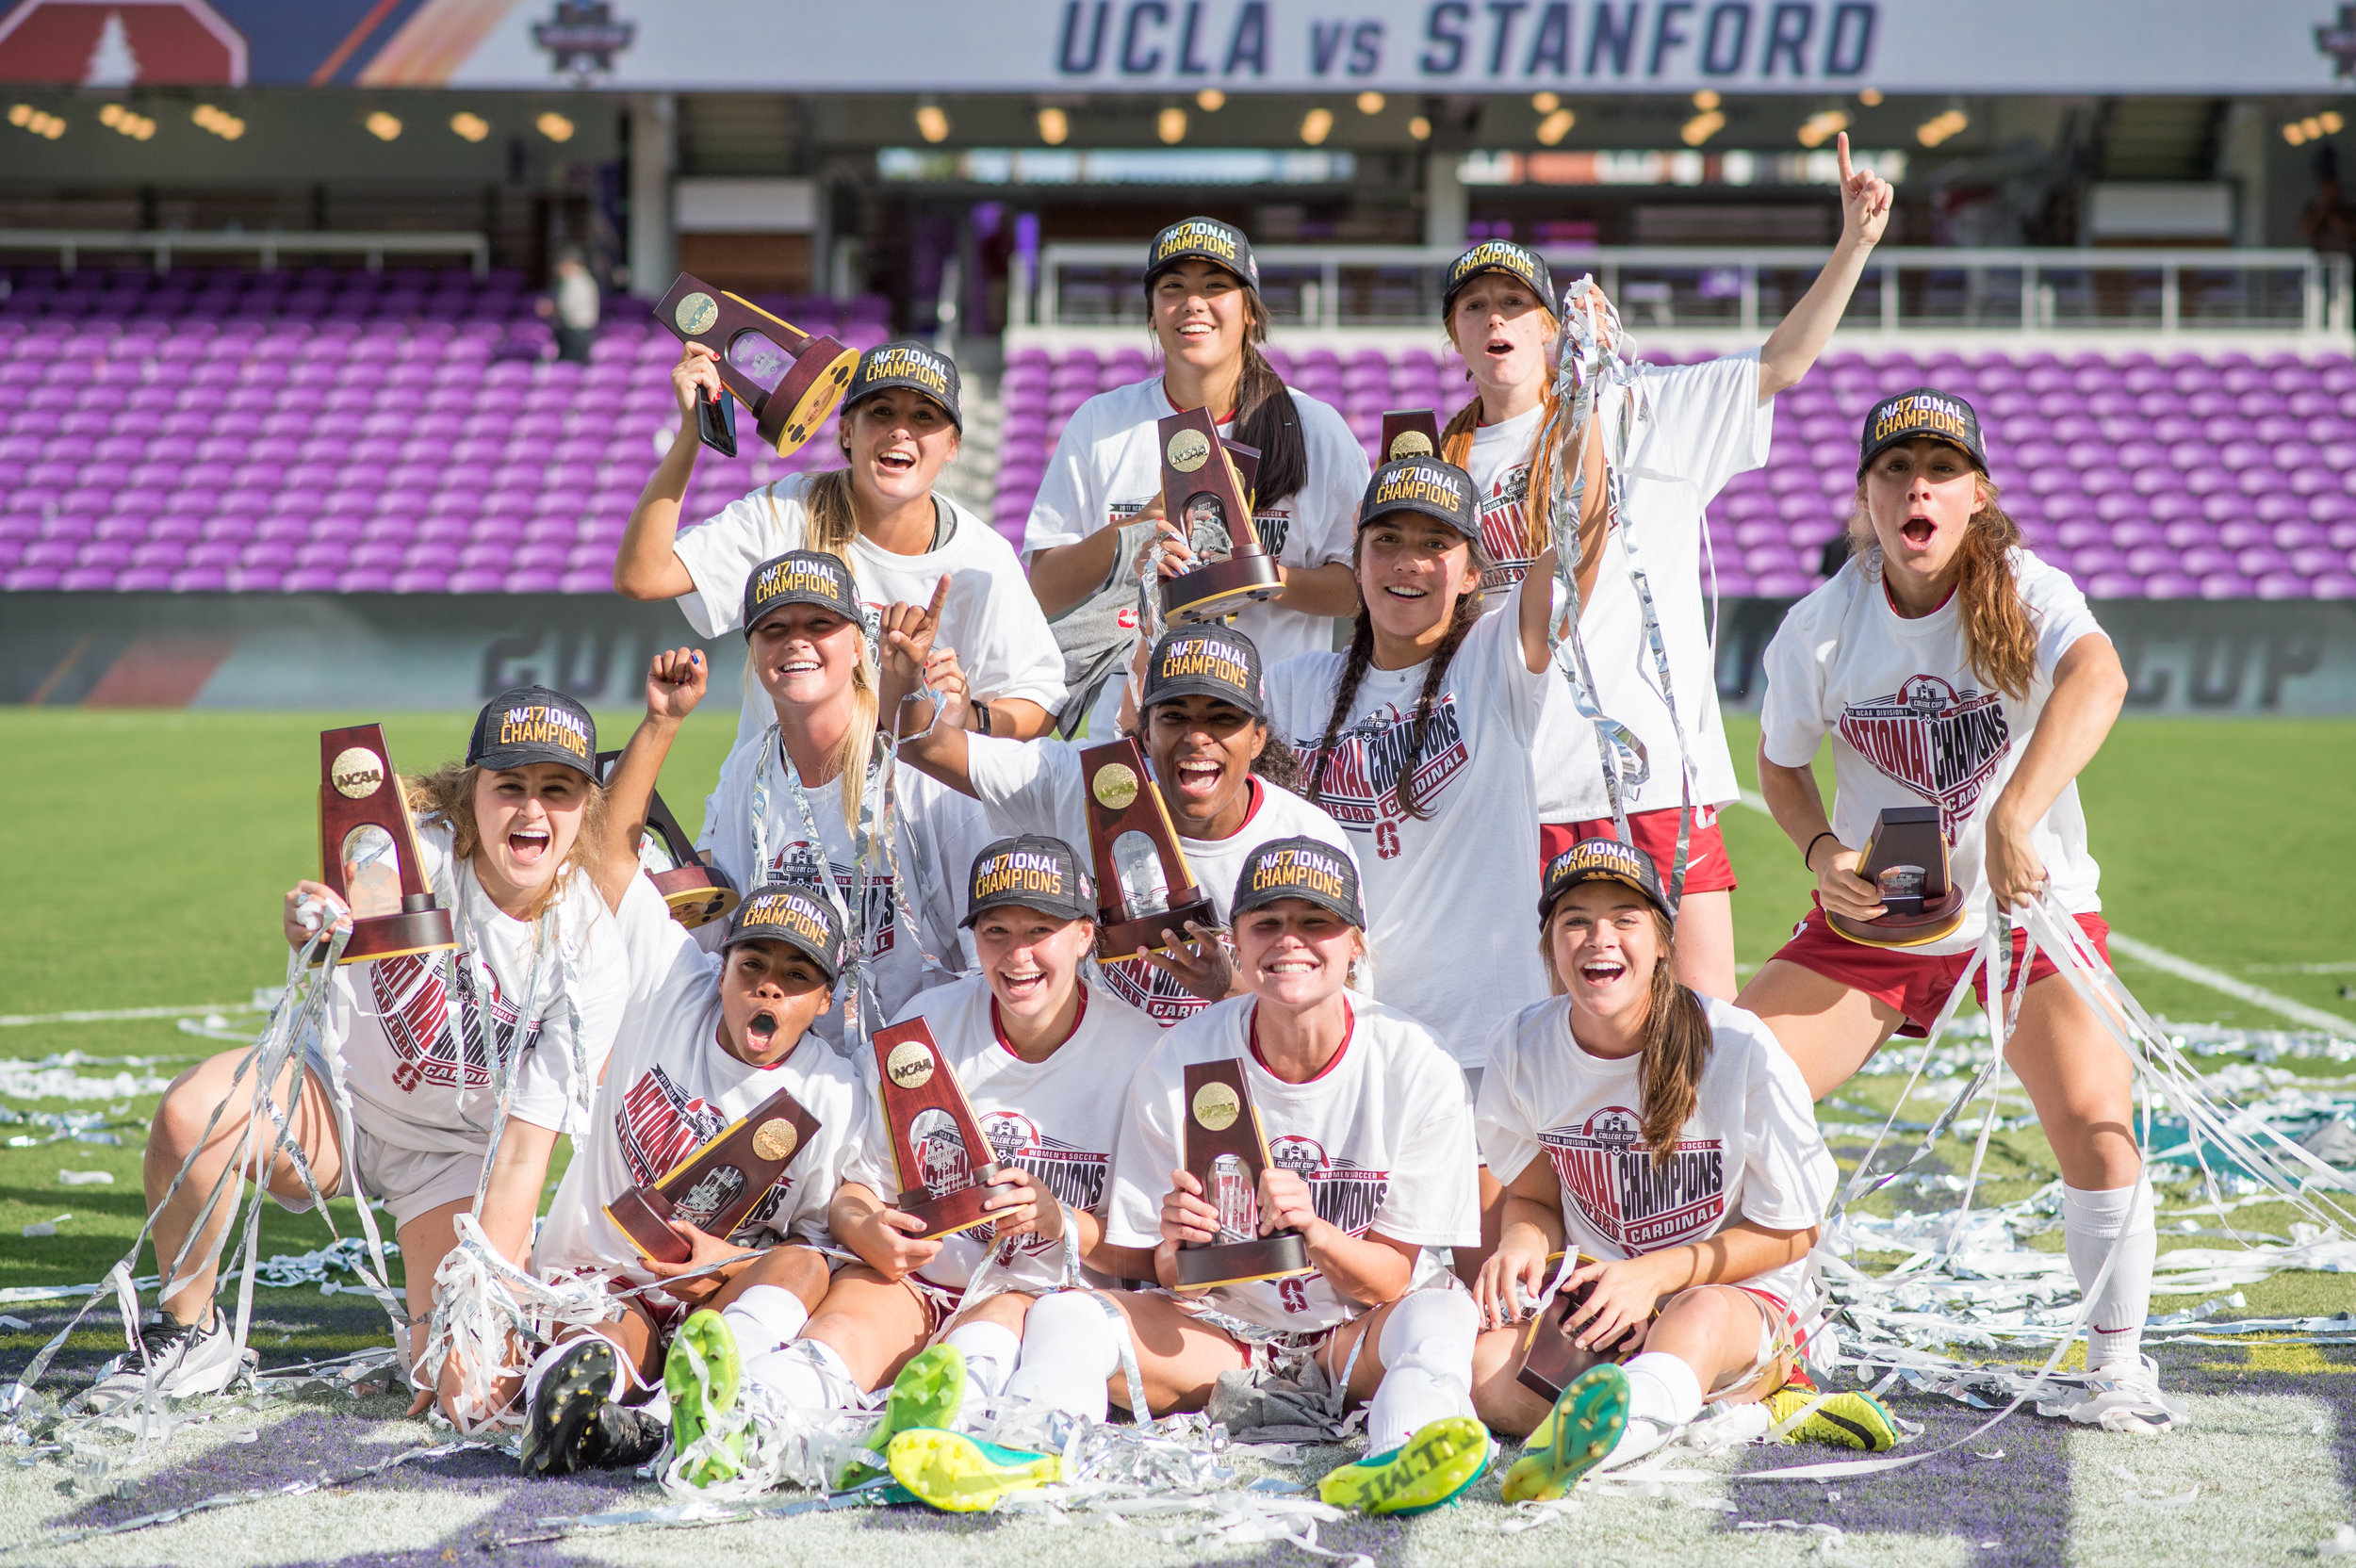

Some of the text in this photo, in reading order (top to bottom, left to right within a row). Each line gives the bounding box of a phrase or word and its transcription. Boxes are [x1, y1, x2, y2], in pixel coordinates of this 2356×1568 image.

[1057, 0, 1268, 76] UCLA
[1419, 0, 1882, 77] STANFORD
[1158, 234, 1236, 261] CHAMPIONS
[1455, 251, 1534, 280] CHAMPIONS
[866, 361, 945, 395] CHAMPIONS
[1875, 409, 1966, 442] CHAMPIONS
[1376, 480, 1461, 513] CHAMPIONS
[756, 573, 839, 605] CHAMPIONS
[1162, 654, 1250, 690] CHAMPIONS
[1932, 699, 1943, 708] CUP
[500, 722, 588, 760] CHAMPIONS
[337, 767, 383, 788] NCAA
[807, 866, 818, 874] CUP
[975, 868, 1063, 901] CHAMPIONS
[1252, 865, 1345, 900] CHAMPIONS
[743, 906, 829, 949] CHAMPIONS
[894, 1057, 933, 1081] NCAA
[1011, 1137, 1023, 1146] CUP
[1028, 1149, 1098, 1162] WOMEN'S SOCCER
[1562, 1137, 1588, 1147] DIVISION
[1681, 1141, 1711, 1150] SOCCER
[1277, 1161, 1315, 1169] COLLEGE CUP
[1618, 1151, 1724, 1222] CHAMPIONS
[1630, 1204, 1720, 1244] CARDINAL
